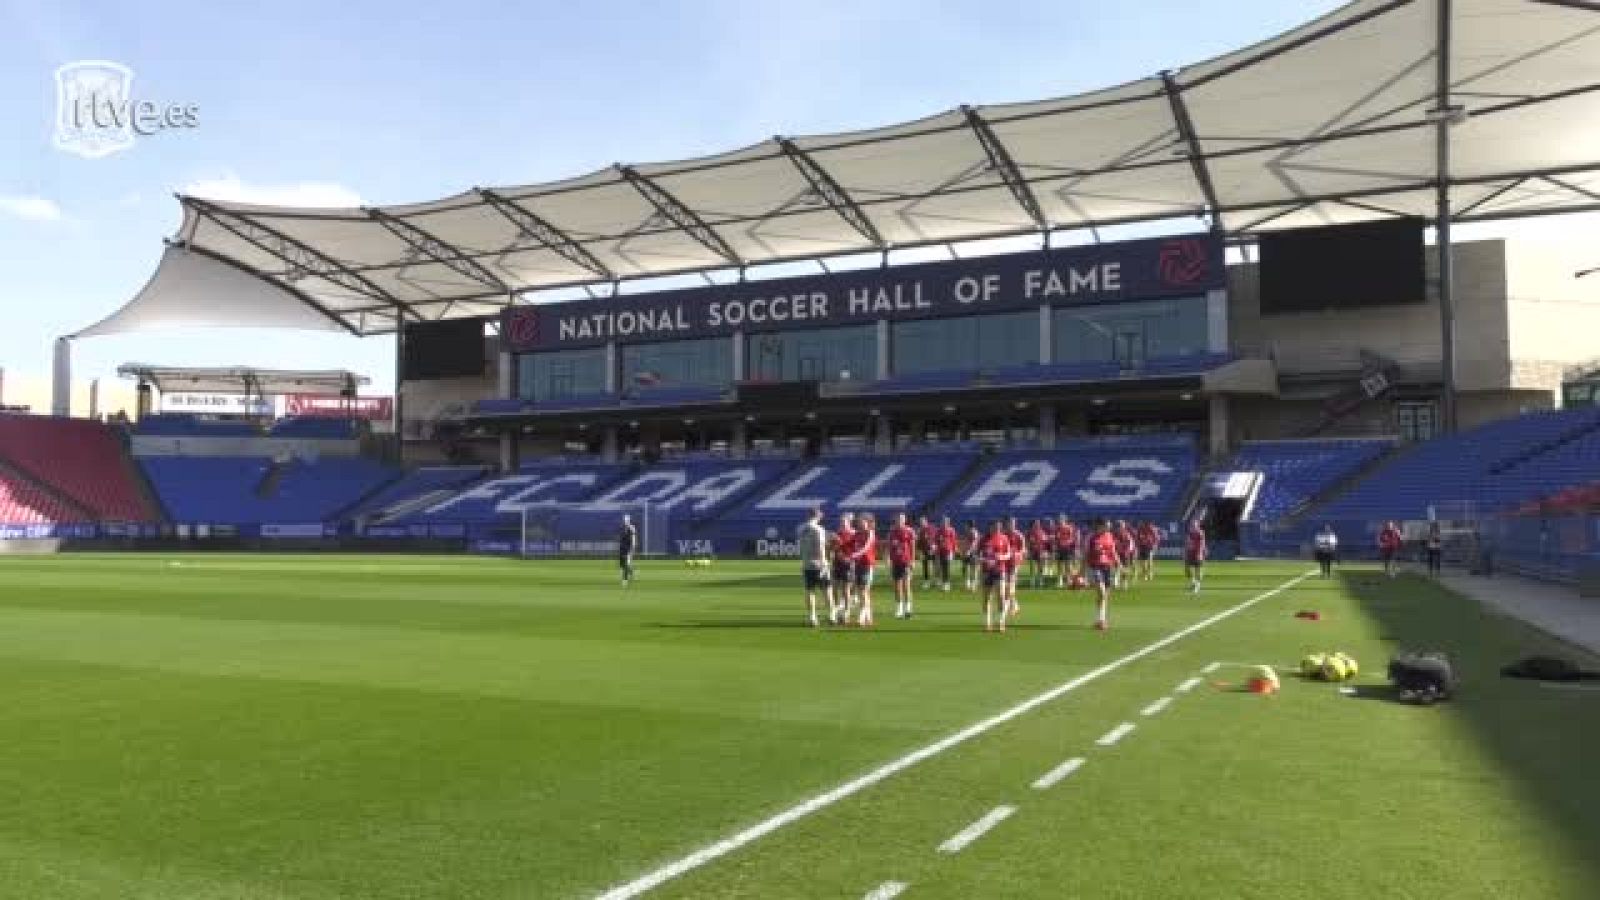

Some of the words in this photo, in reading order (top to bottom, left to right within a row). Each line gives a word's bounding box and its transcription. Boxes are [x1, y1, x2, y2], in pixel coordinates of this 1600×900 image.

[559, 305, 691, 341] NATIONAL
[708, 292, 828, 326] SOCCER
[849, 282, 932, 315] HALL
[954, 274, 1001, 303] OF
[1023, 262, 1121, 299] FAME
[424, 473, 599, 513] FC
[580, 459, 1173, 512] DALLAS
